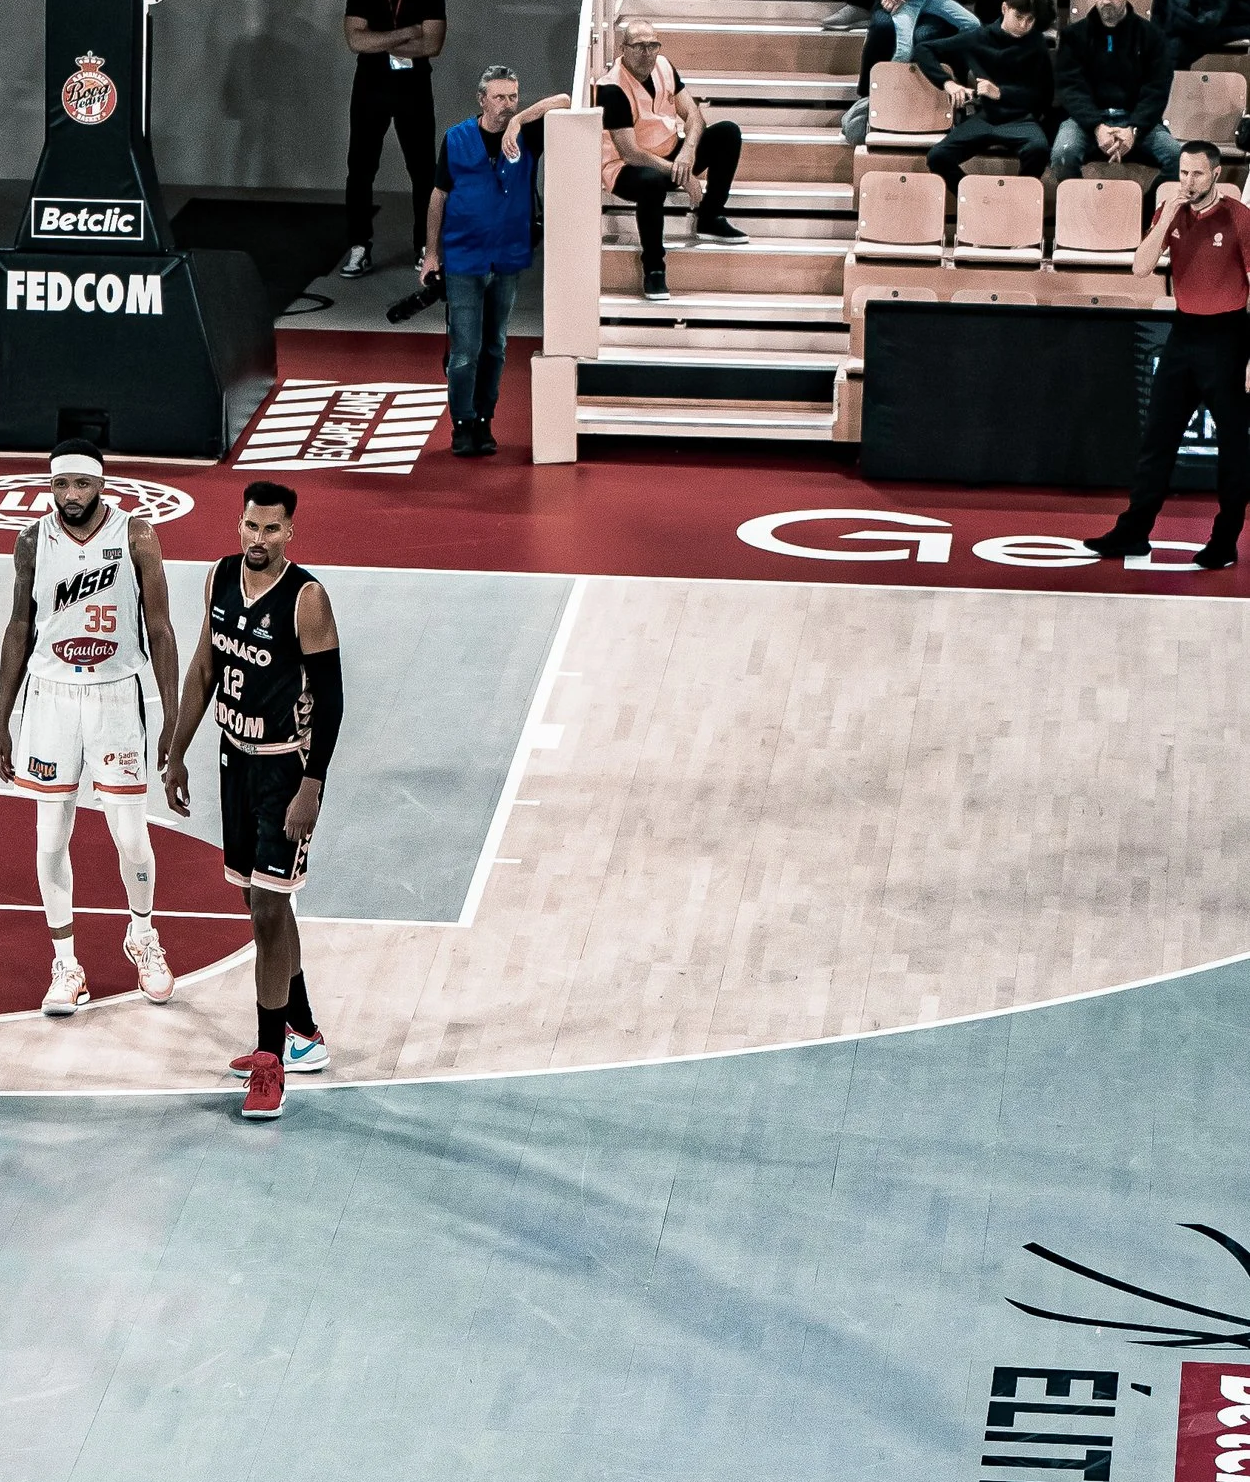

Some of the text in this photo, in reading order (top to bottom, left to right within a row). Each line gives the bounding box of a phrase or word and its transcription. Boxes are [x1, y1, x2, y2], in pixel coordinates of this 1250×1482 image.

[66, 80, 112, 104] Roca
[40, 207, 135, 233] Betclic
[6, 270, 163, 315] FEDCOM
[303, 391, 388, 461] ESCAPE LANE
[52, 562, 120, 615] MSB
[85, 605, 117, 633] 35
[63, 641, 115, 661] Gaulois
[211, 628, 272, 667] MONACO
[223, 665, 245, 701] 12
